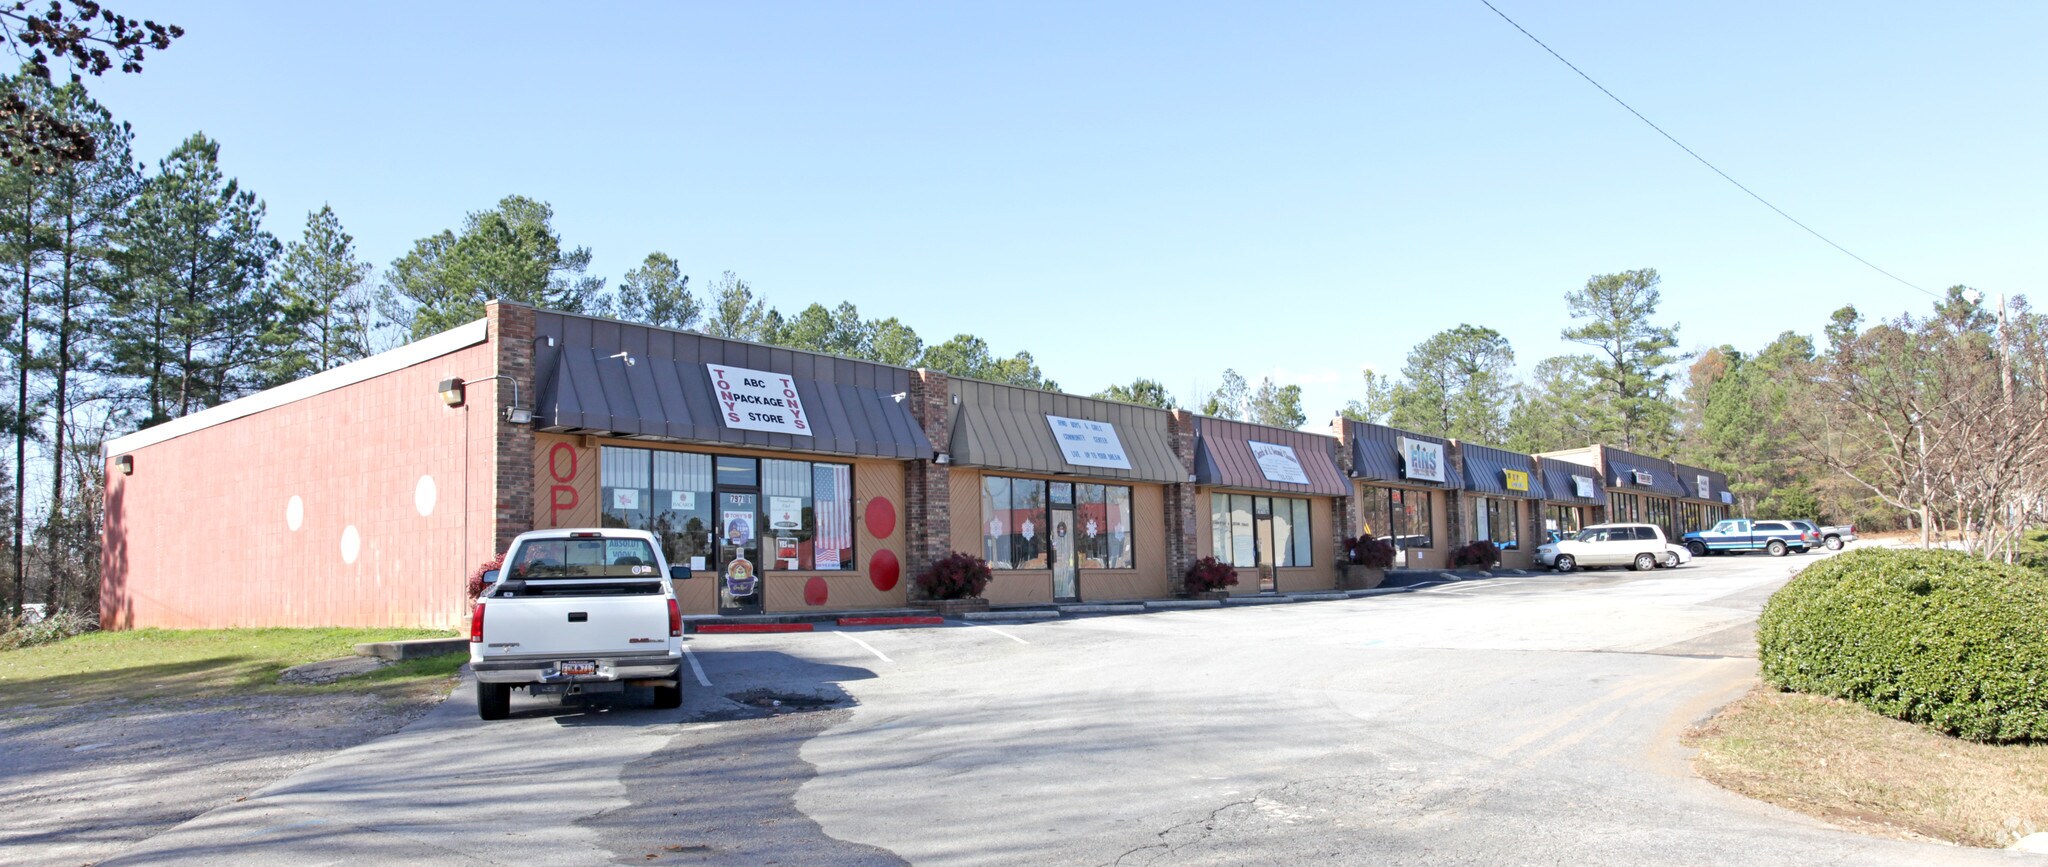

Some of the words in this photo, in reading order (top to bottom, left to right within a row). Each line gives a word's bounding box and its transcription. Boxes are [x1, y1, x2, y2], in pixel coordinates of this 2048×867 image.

[744, 378, 766, 388] ABC
[713, 368, 740, 423] TONYS
[733, 393, 784, 407] PACKAGE
[779, 378, 806, 429] TONYS
[748, 412, 785, 424] STORE
[609, 540, 640, 548] ABSOLUT
